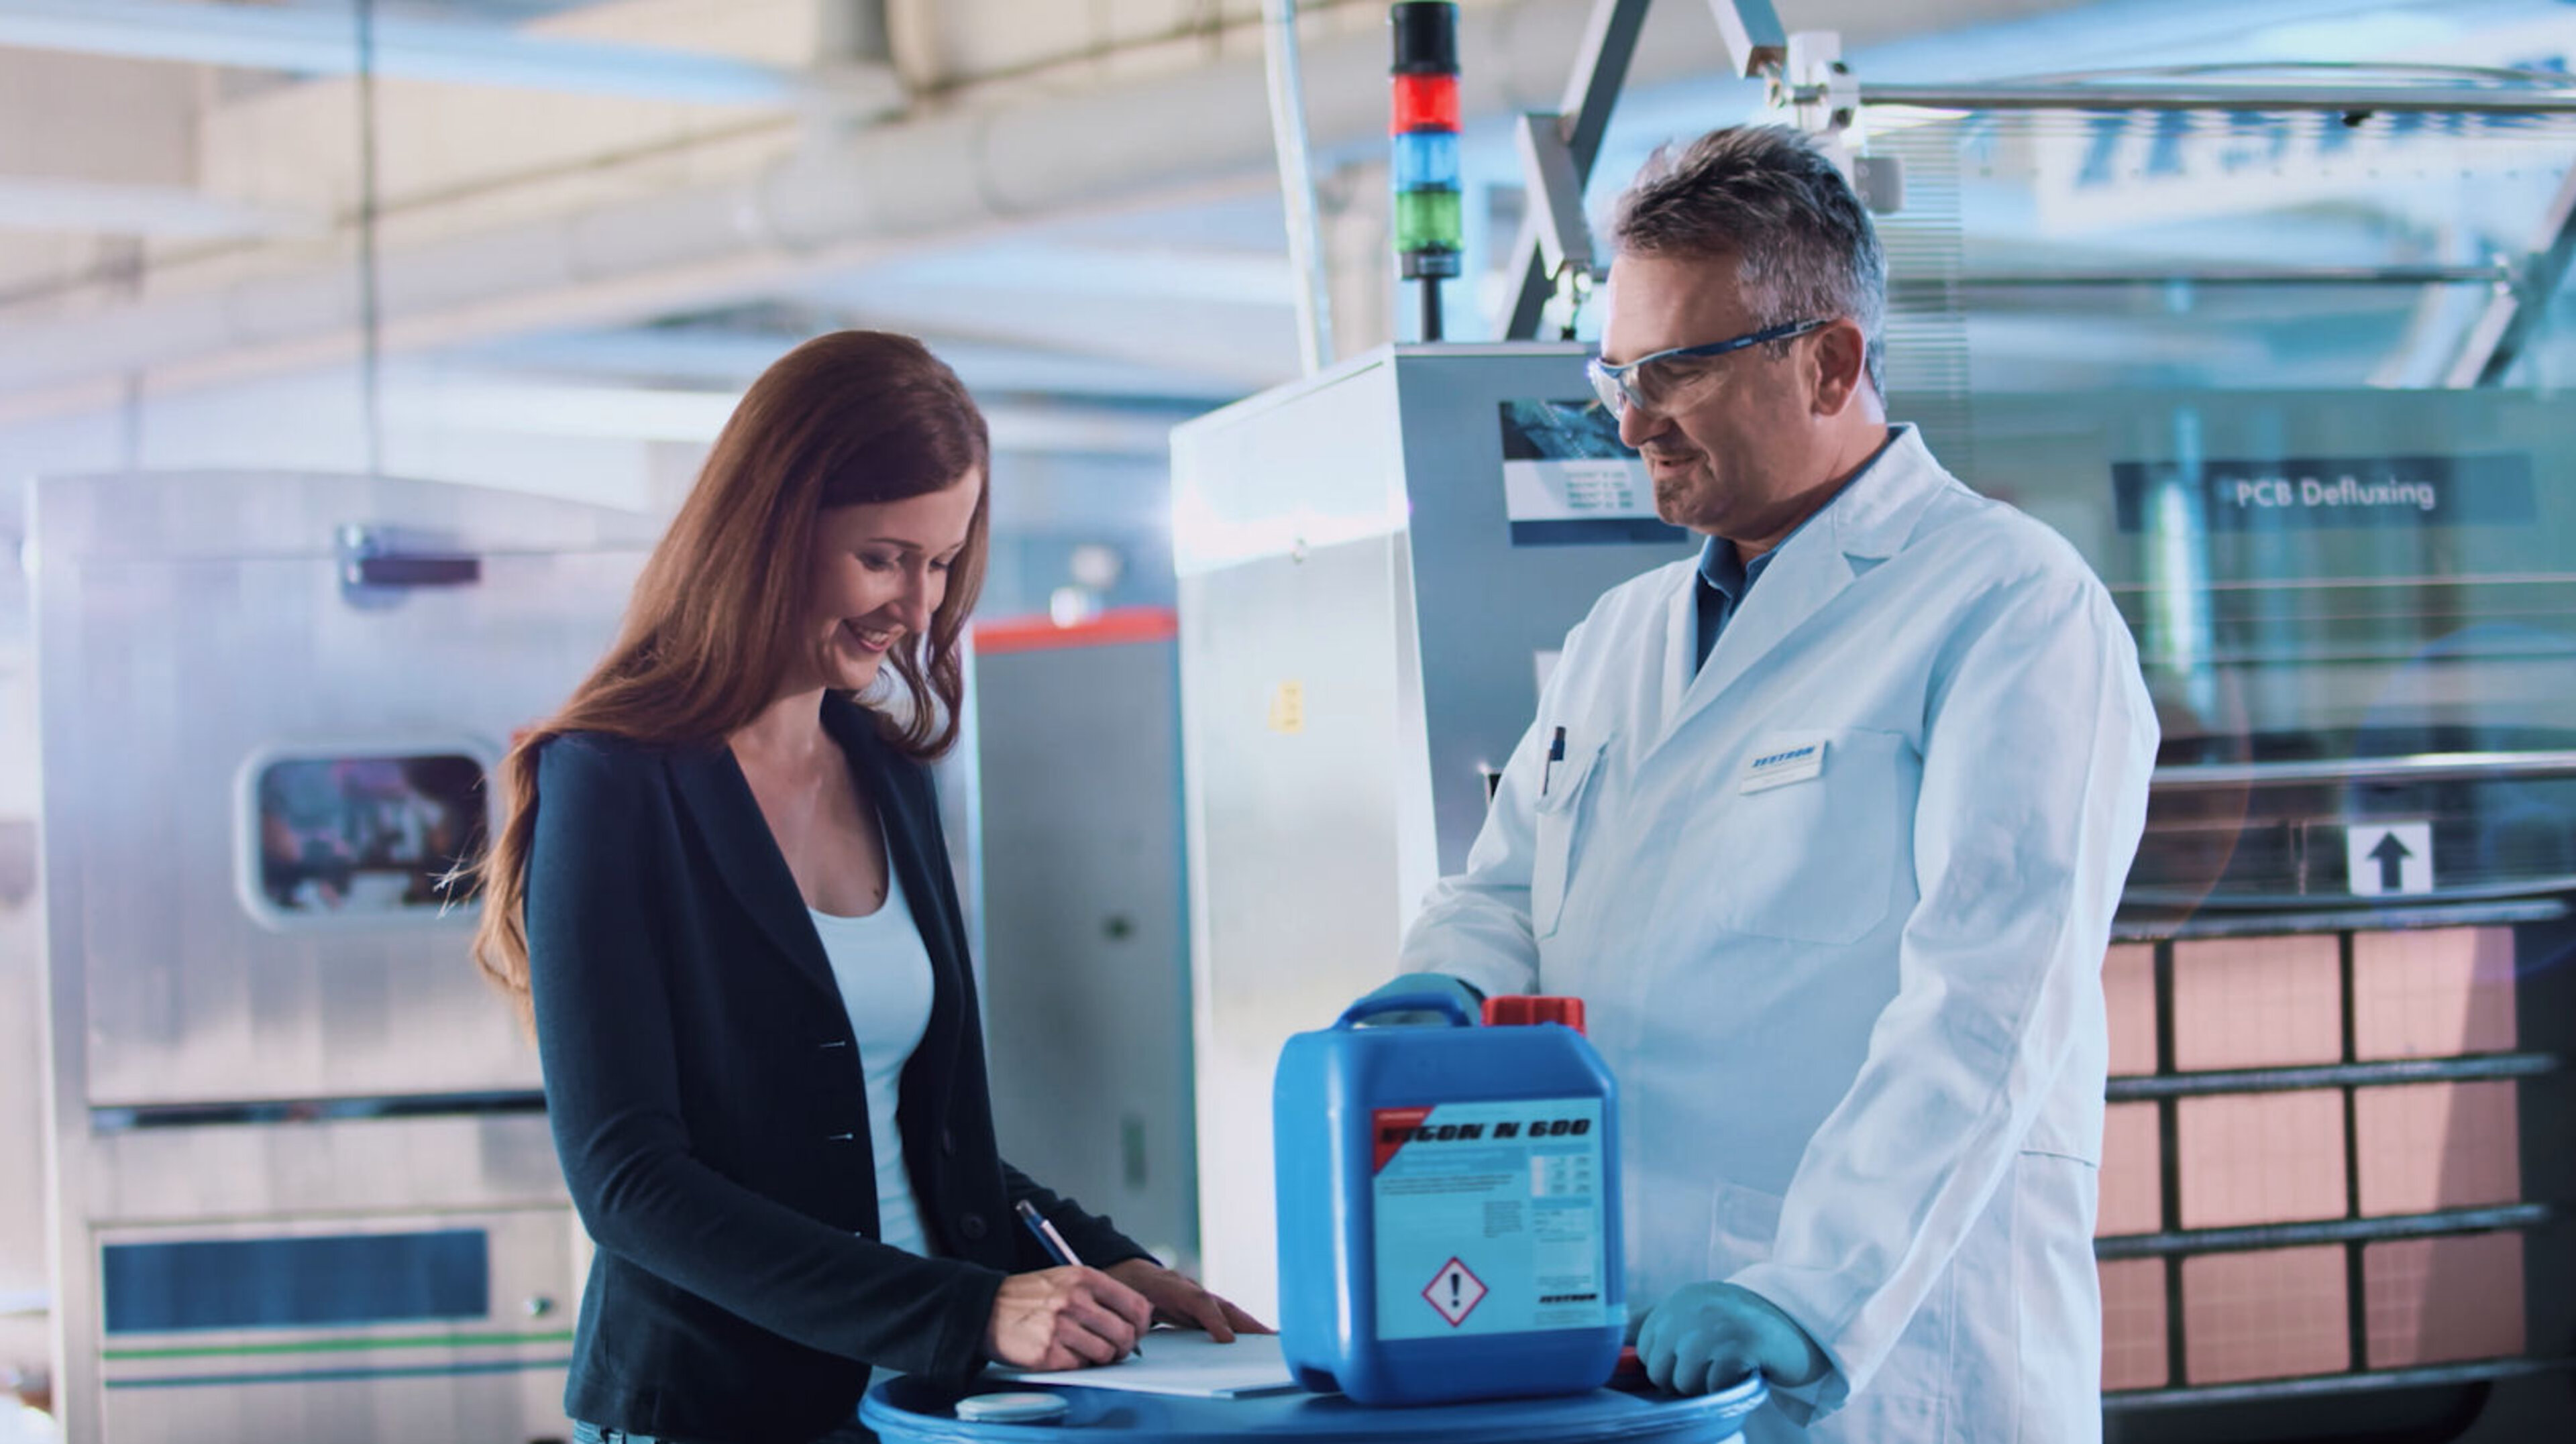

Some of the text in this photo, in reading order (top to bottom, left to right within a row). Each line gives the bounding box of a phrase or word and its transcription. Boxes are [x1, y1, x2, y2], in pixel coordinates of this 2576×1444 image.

[2237, 474, 2435, 510] PCB Defluxing
[1493, 1122, 1521, 1139] N
[1528, 1119, 1590, 1136] 600
